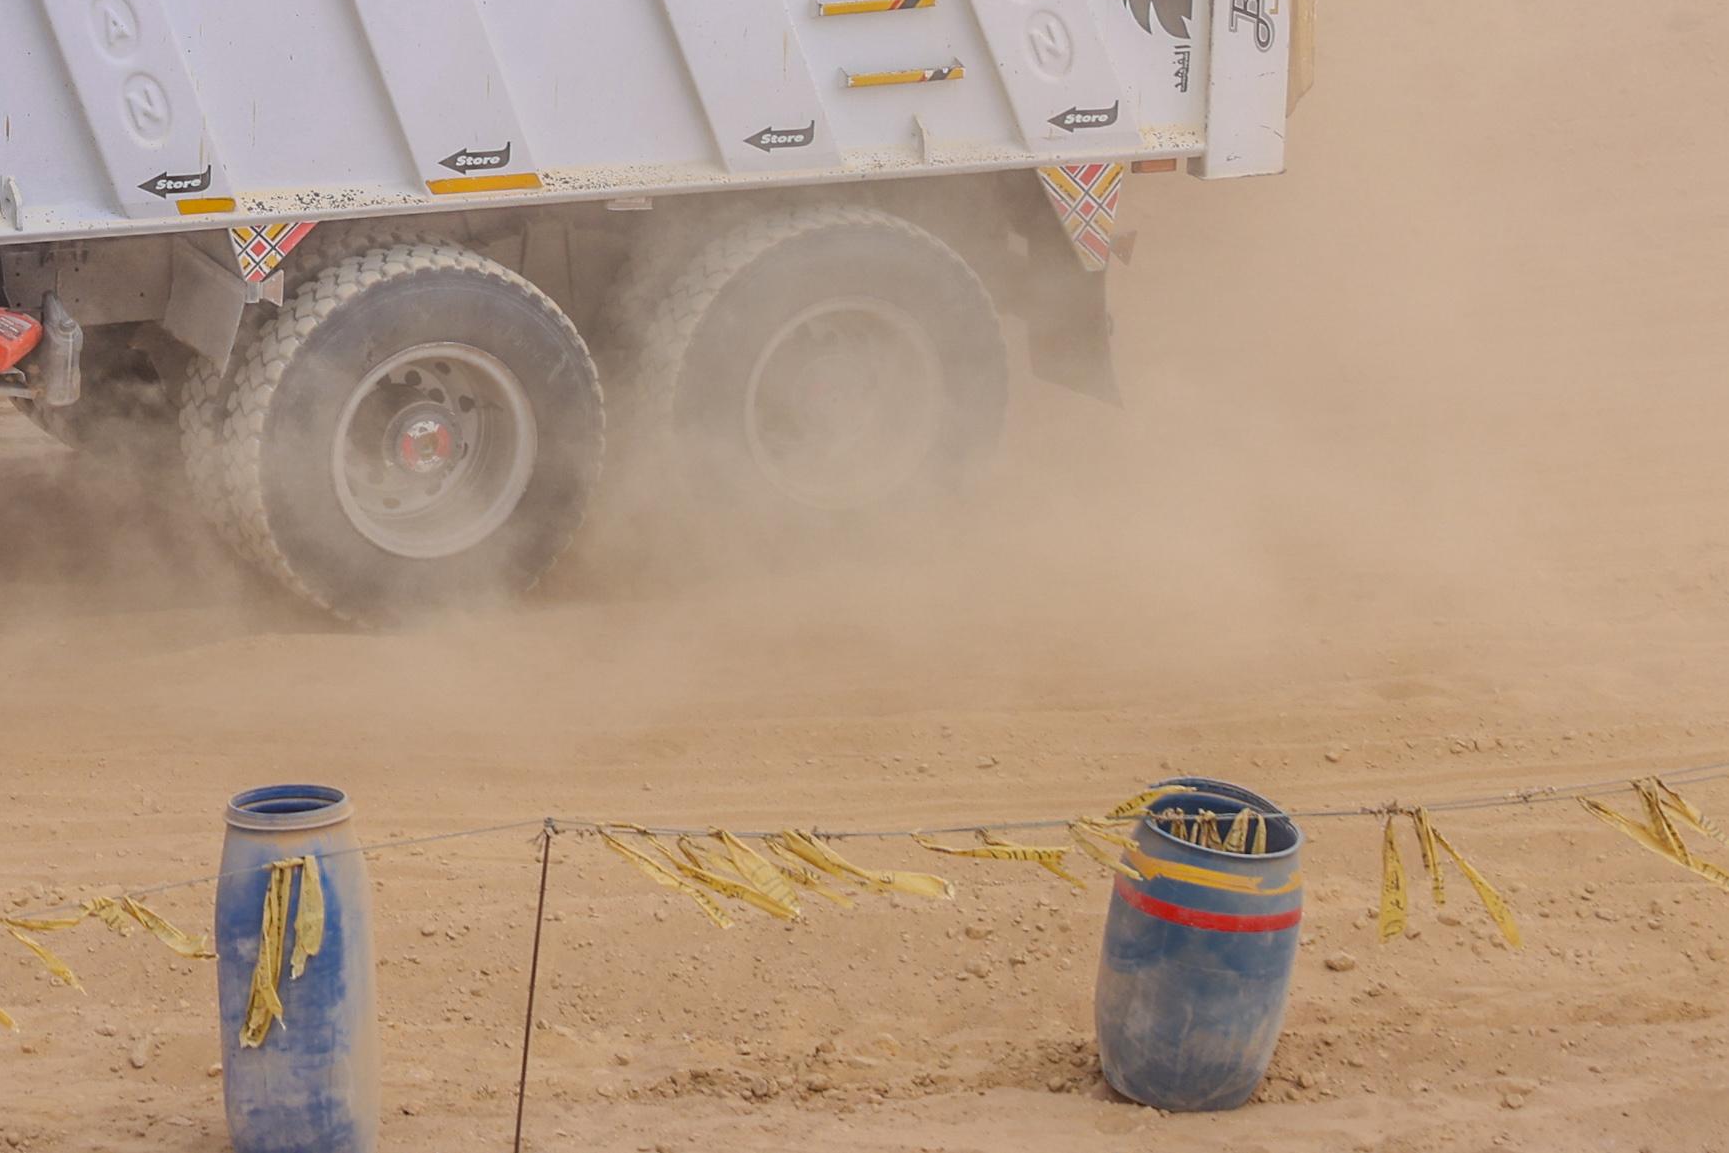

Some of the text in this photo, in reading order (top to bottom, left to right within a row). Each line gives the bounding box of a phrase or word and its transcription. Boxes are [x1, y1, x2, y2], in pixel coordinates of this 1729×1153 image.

[1064, 112, 1109, 126] Store
[760, 131, 804, 145] Store
[455, 152, 501, 167] Store
[155, 177, 201, 192] Store
